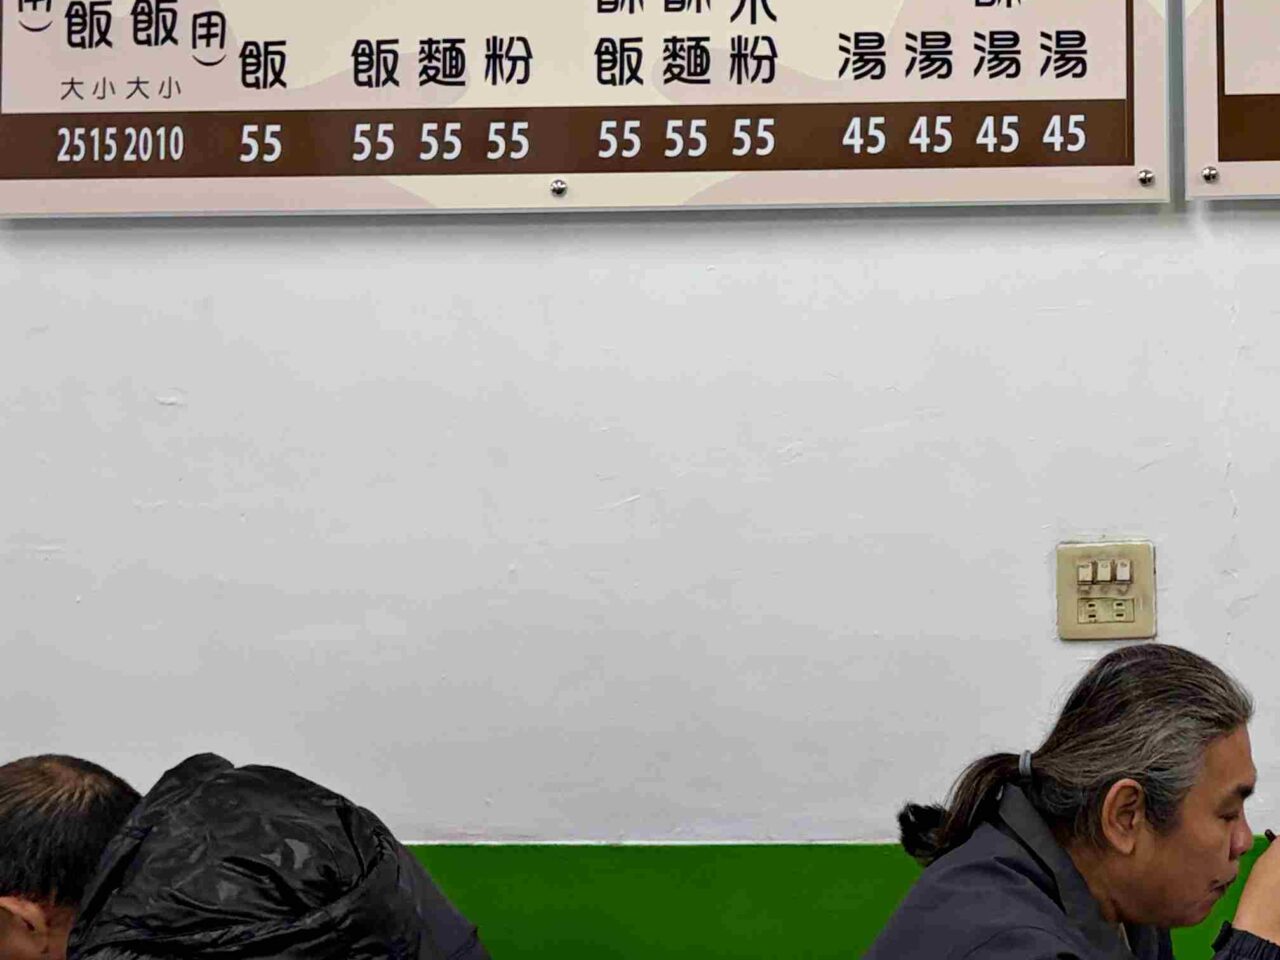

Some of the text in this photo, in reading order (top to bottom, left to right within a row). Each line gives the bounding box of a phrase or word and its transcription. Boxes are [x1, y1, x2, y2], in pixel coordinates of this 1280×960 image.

[241, 125, 281, 161] 55
[353, 124, 394, 160] 55
[420, 123, 461, 159] 55
[488, 122, 528, 159] 55
[599, 121, 640, 157] 55
[665, 120, 706, 156] 55
[733, 119, 774, 155] 55
[843, 117, 885, 153] 45
[910, 116, 951, 152] 45
[977, 116, 1018, 152] 45
[1043, 115, 1085, 151] 45
